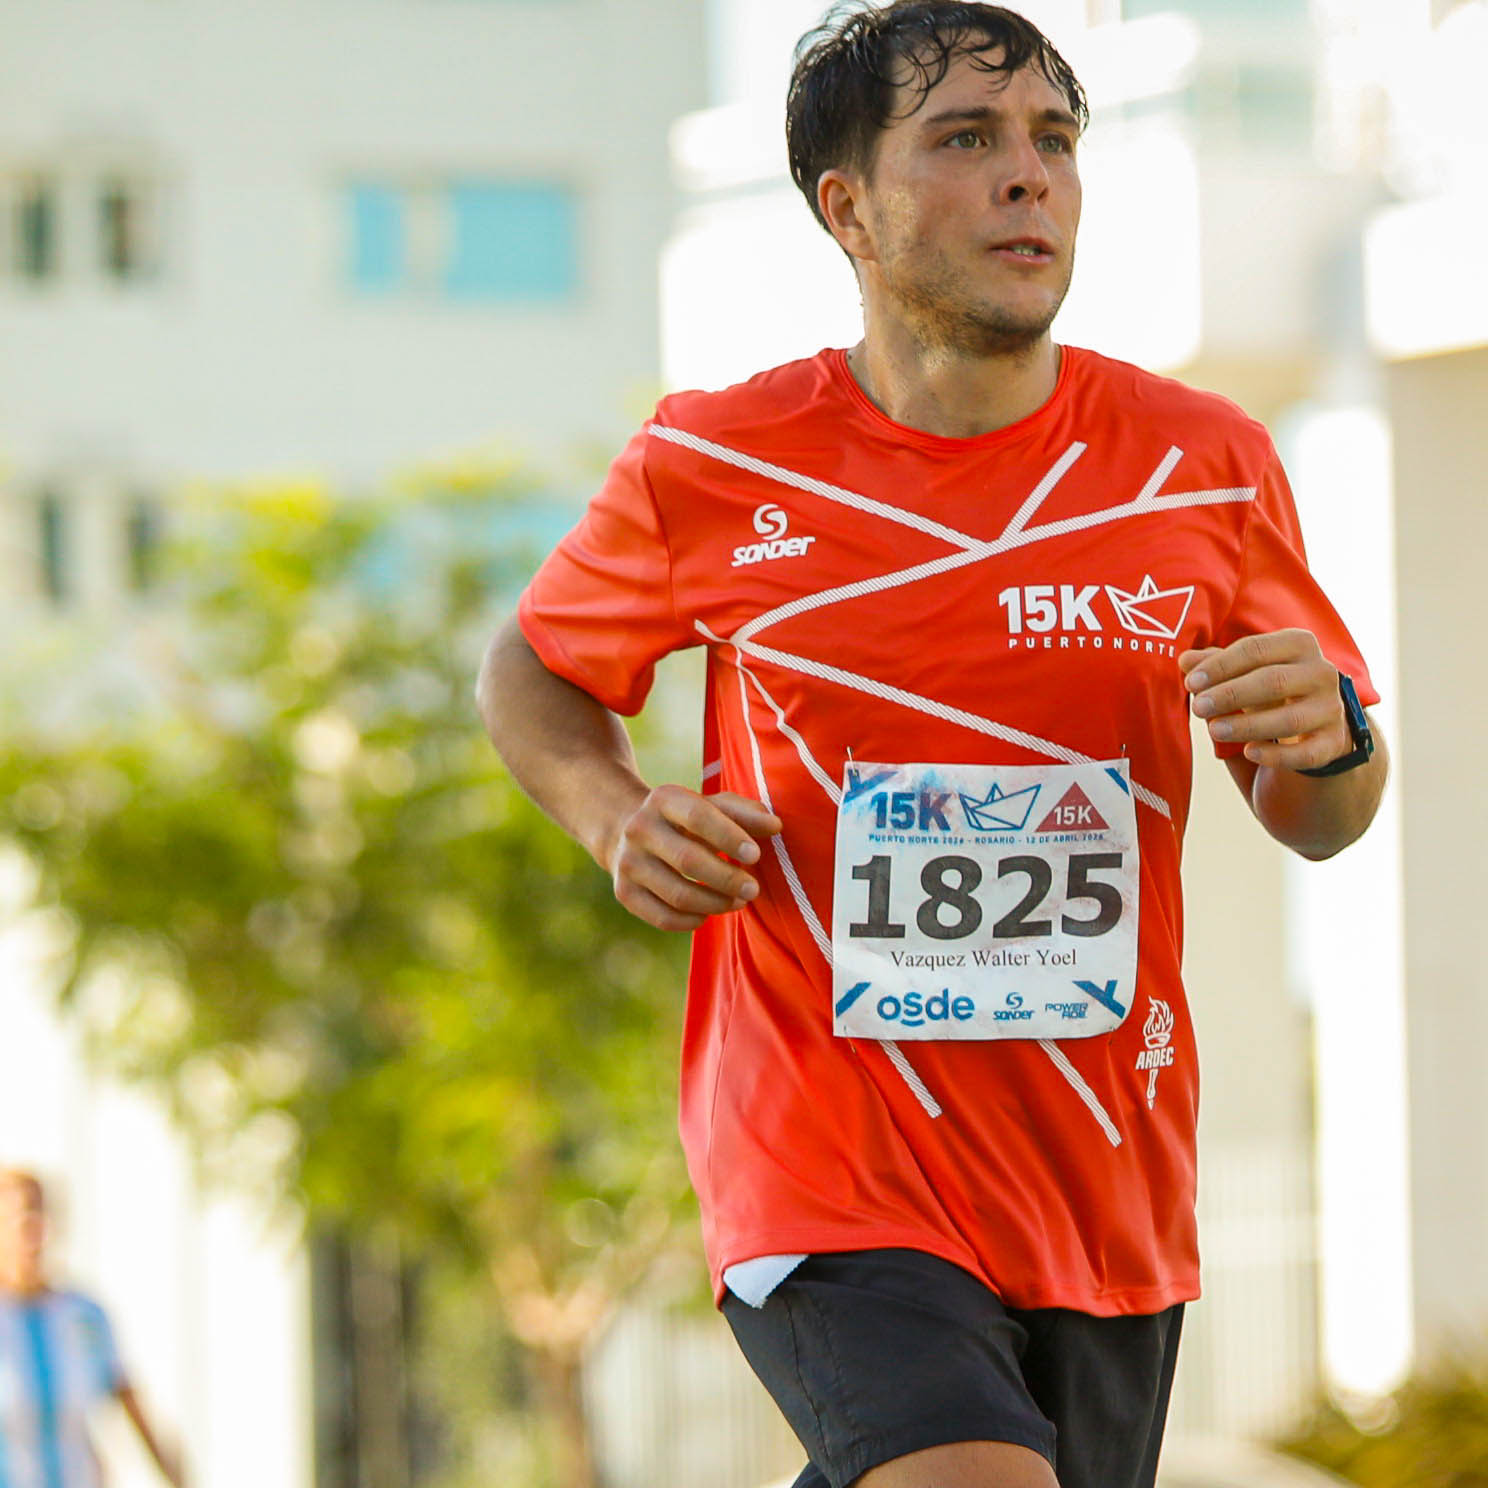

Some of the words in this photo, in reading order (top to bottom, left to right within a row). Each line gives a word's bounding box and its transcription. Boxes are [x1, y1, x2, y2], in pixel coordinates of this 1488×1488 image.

[998, 584, 1103, 634] 15K
[1008, 636, 1103, 650] PUERTO
[1113, 637, 1174, 658] NORTE
[870, 791, 952, 832] 15K
[1053, 805, 1095, 826] 15K
[868, 833, 905, 844] PUERTO
[908, 836, 939, 845] NORTE
[975, 836, 1015, 845] ROSARIO
[1026, 836, 1036, 844] 12
[1039, 836, 1050, 844] DE
[1054, 834, 1078, 844] ABRIL
[849, 852, 1124, 941] 1825
[890, 951, 966, 972] Vazquez
[972, 949, 1031, 967] Walter
[1036, 948, 1078, 967] Yoel
[876, 987, 976, 1023] osde
[1135, 1046, 1175, 1070] ARDEC
